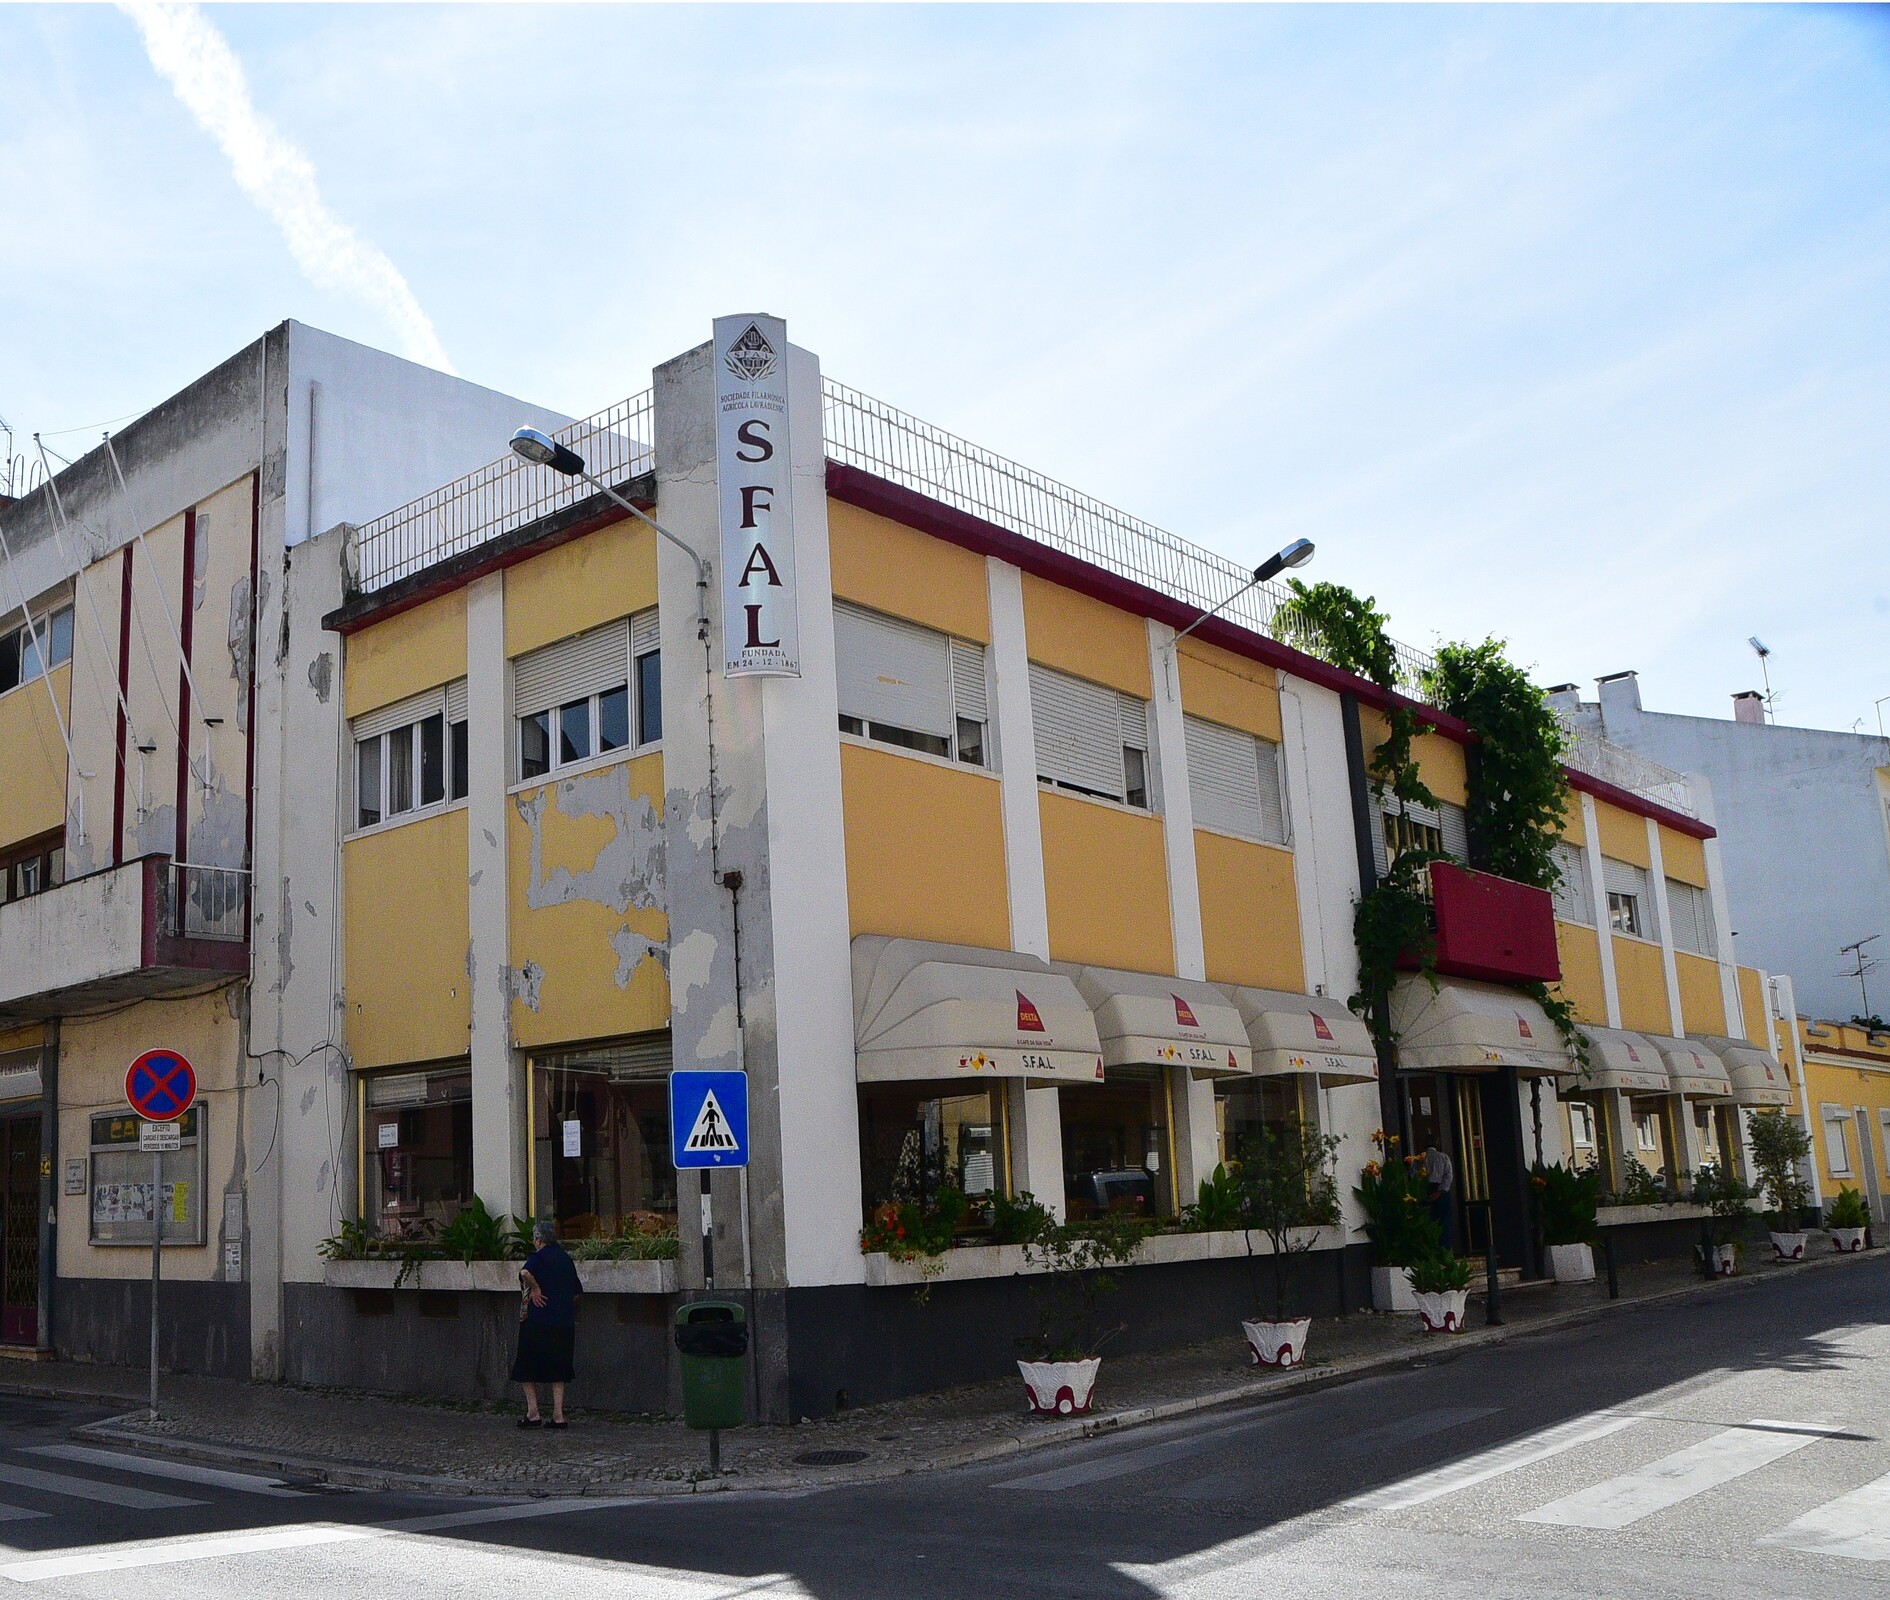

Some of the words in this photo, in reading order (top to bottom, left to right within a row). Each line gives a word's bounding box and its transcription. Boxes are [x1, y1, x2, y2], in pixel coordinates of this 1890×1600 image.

[720, 391, 750, 403] SOCIEDADE
[741, 649, 787, 658] FUNDADA
[727, 660, 740, 670] EM
[742, 659, 753, 667] 24
[763, 658, 772, 666] 12
[781, 659, 798, 669] 1867
[1020, 1013, 1039, 1022] DELTA
[1022, 1055, 1055, 1069] S.F.A.L.
[152, 1124, 170, 1132] EXCEPTO
